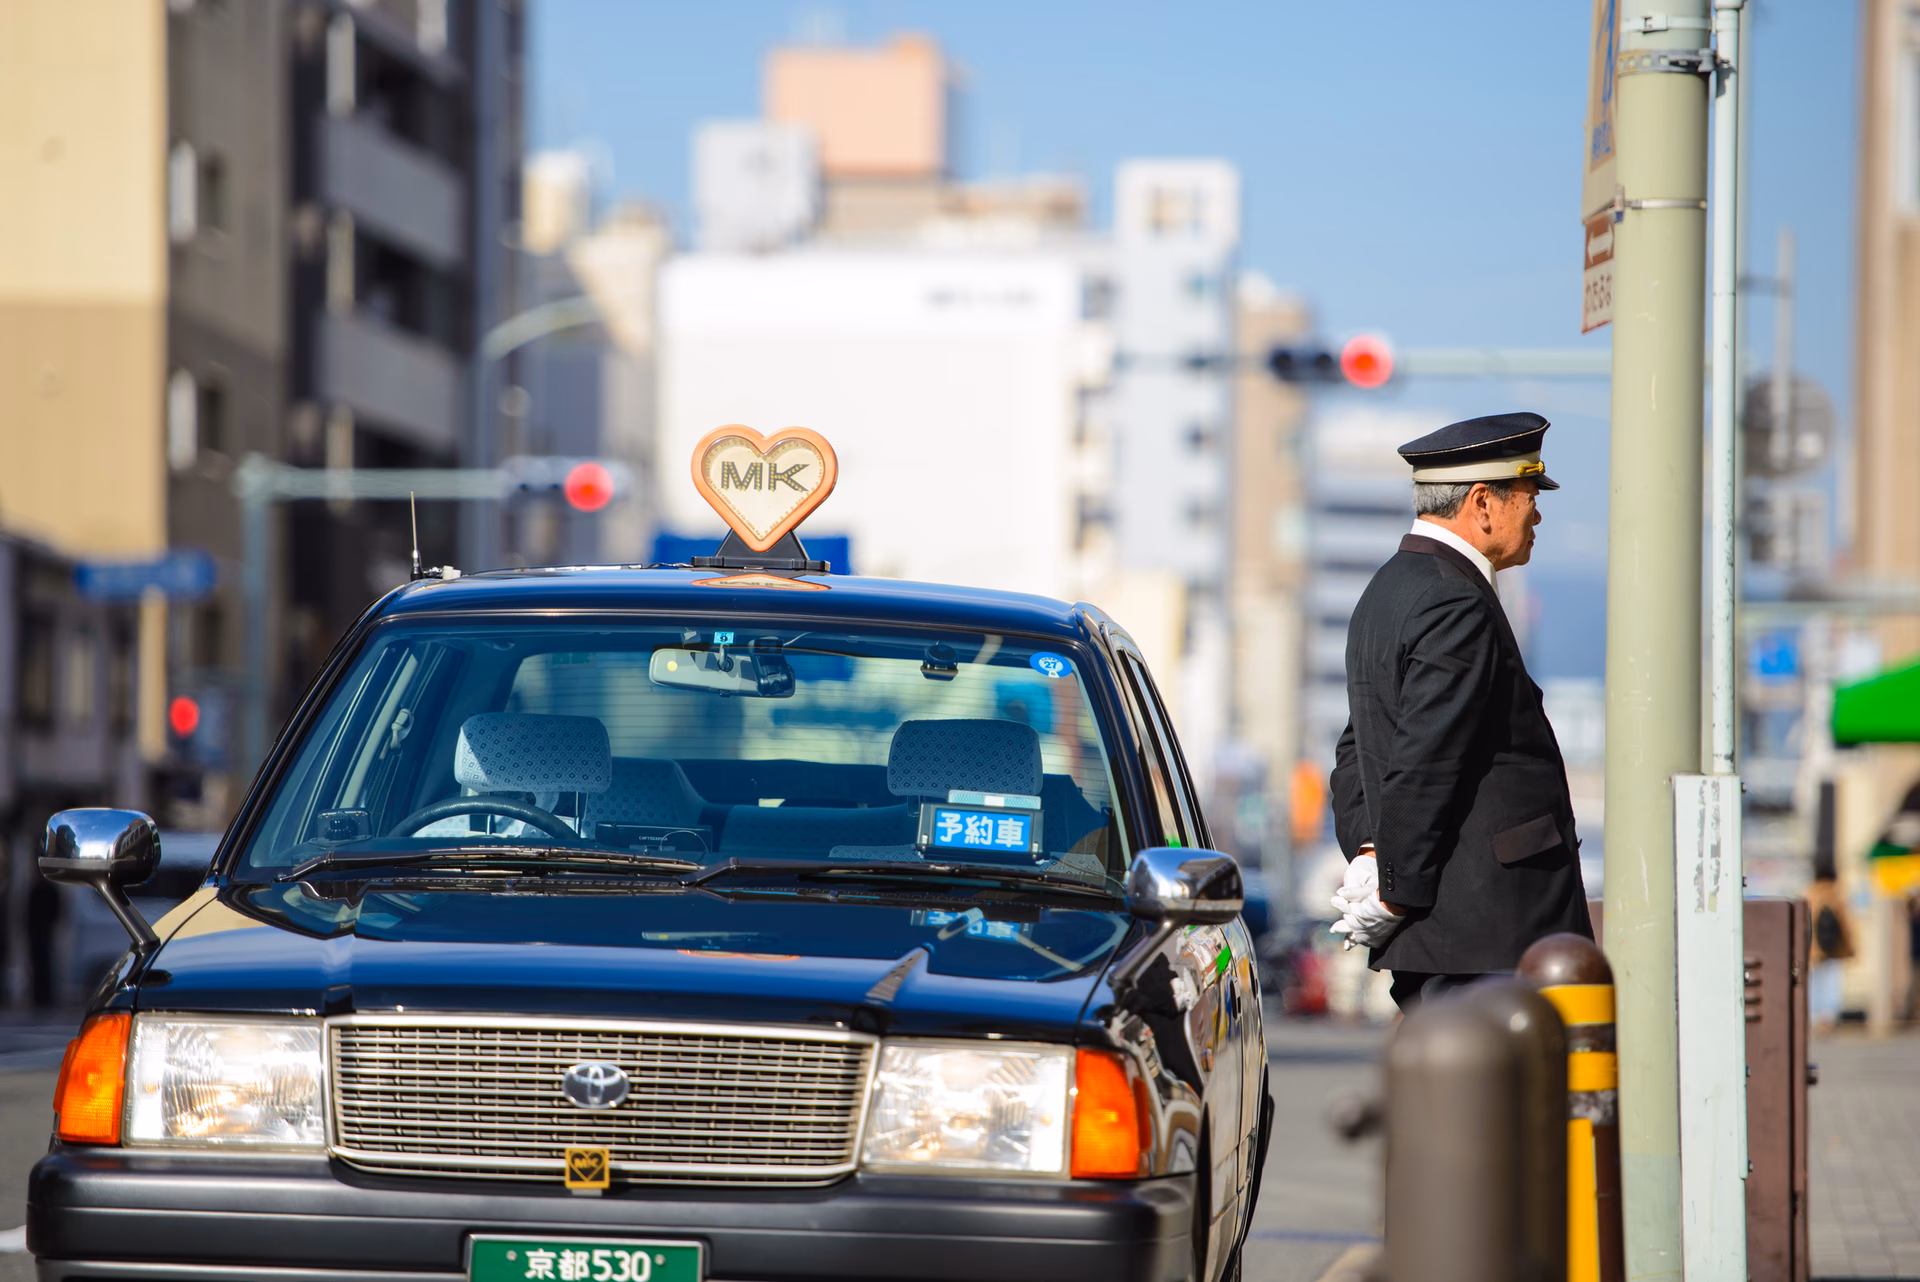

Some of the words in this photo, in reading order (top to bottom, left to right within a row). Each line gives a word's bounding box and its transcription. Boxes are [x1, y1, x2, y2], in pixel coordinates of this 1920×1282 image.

[721, 461, 810, 491] MK
[1043, 661, 1057, 669] 27
[937, 812, 1024, 847] 予約車
[524, 1248, 651, 1282] 京都530
